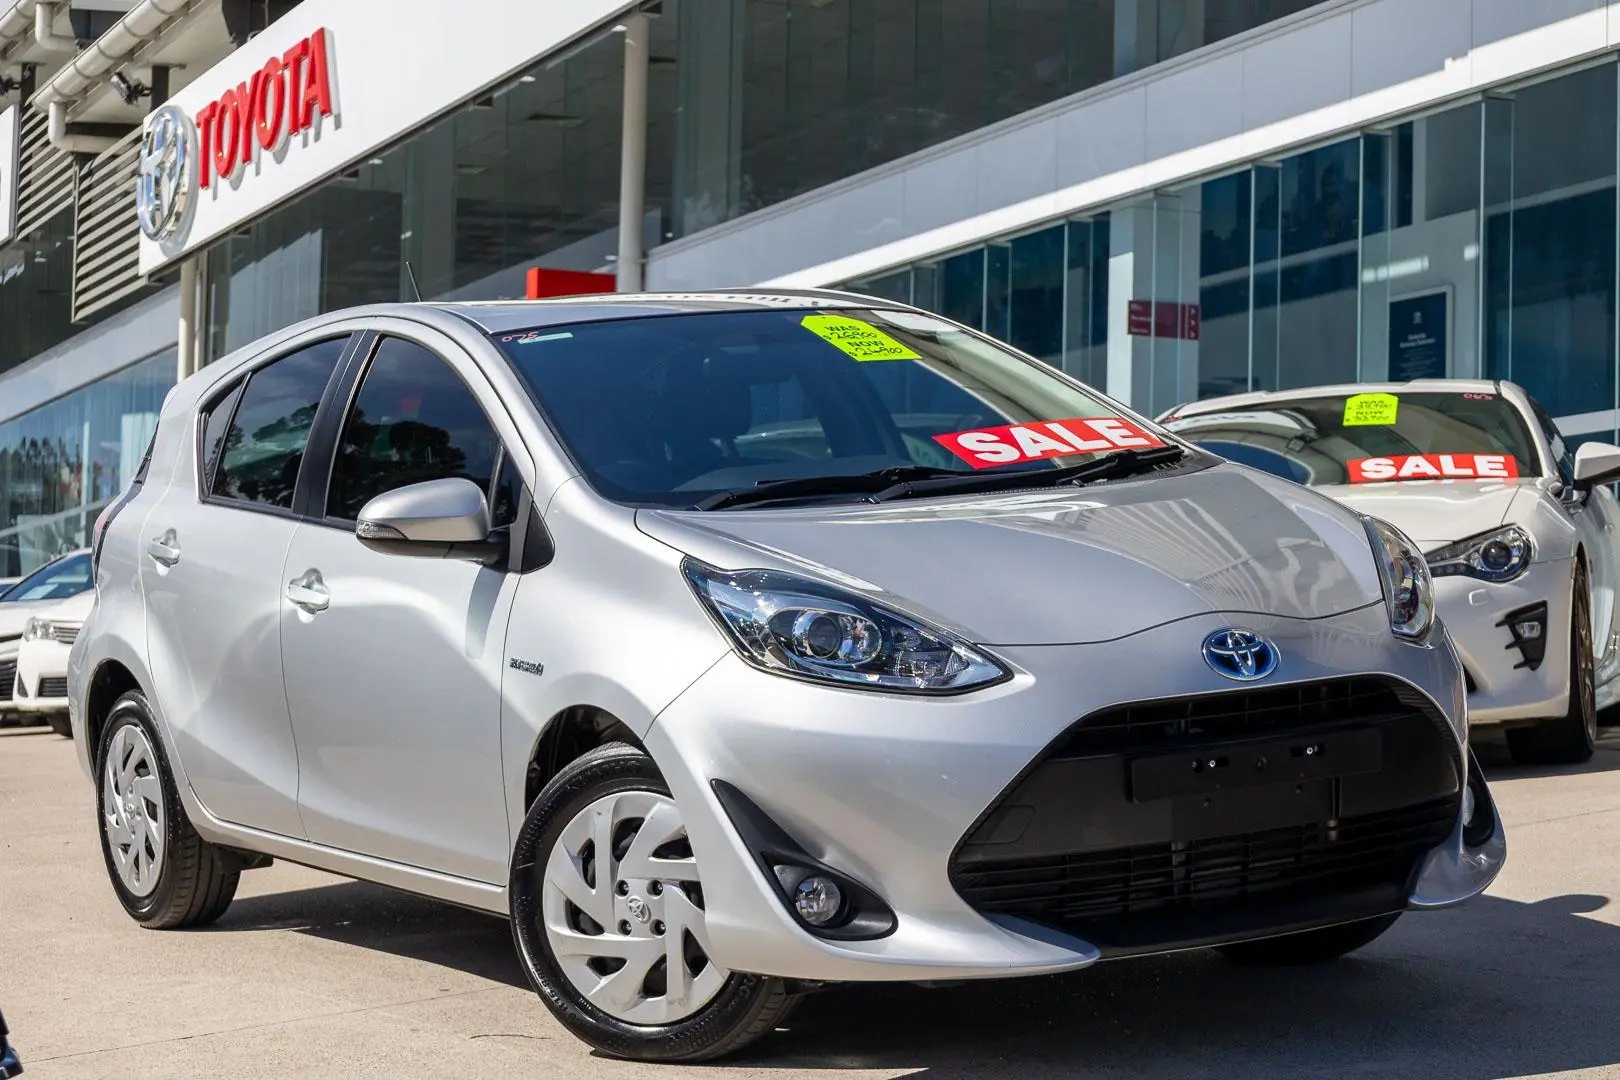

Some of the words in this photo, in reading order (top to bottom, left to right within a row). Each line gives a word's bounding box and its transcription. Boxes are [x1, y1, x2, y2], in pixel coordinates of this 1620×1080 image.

[196, 27, 332, 190] TOYOTA
[957, 419, 1151, 462] SALE
[1360, 454, 1509, 479] SALE
